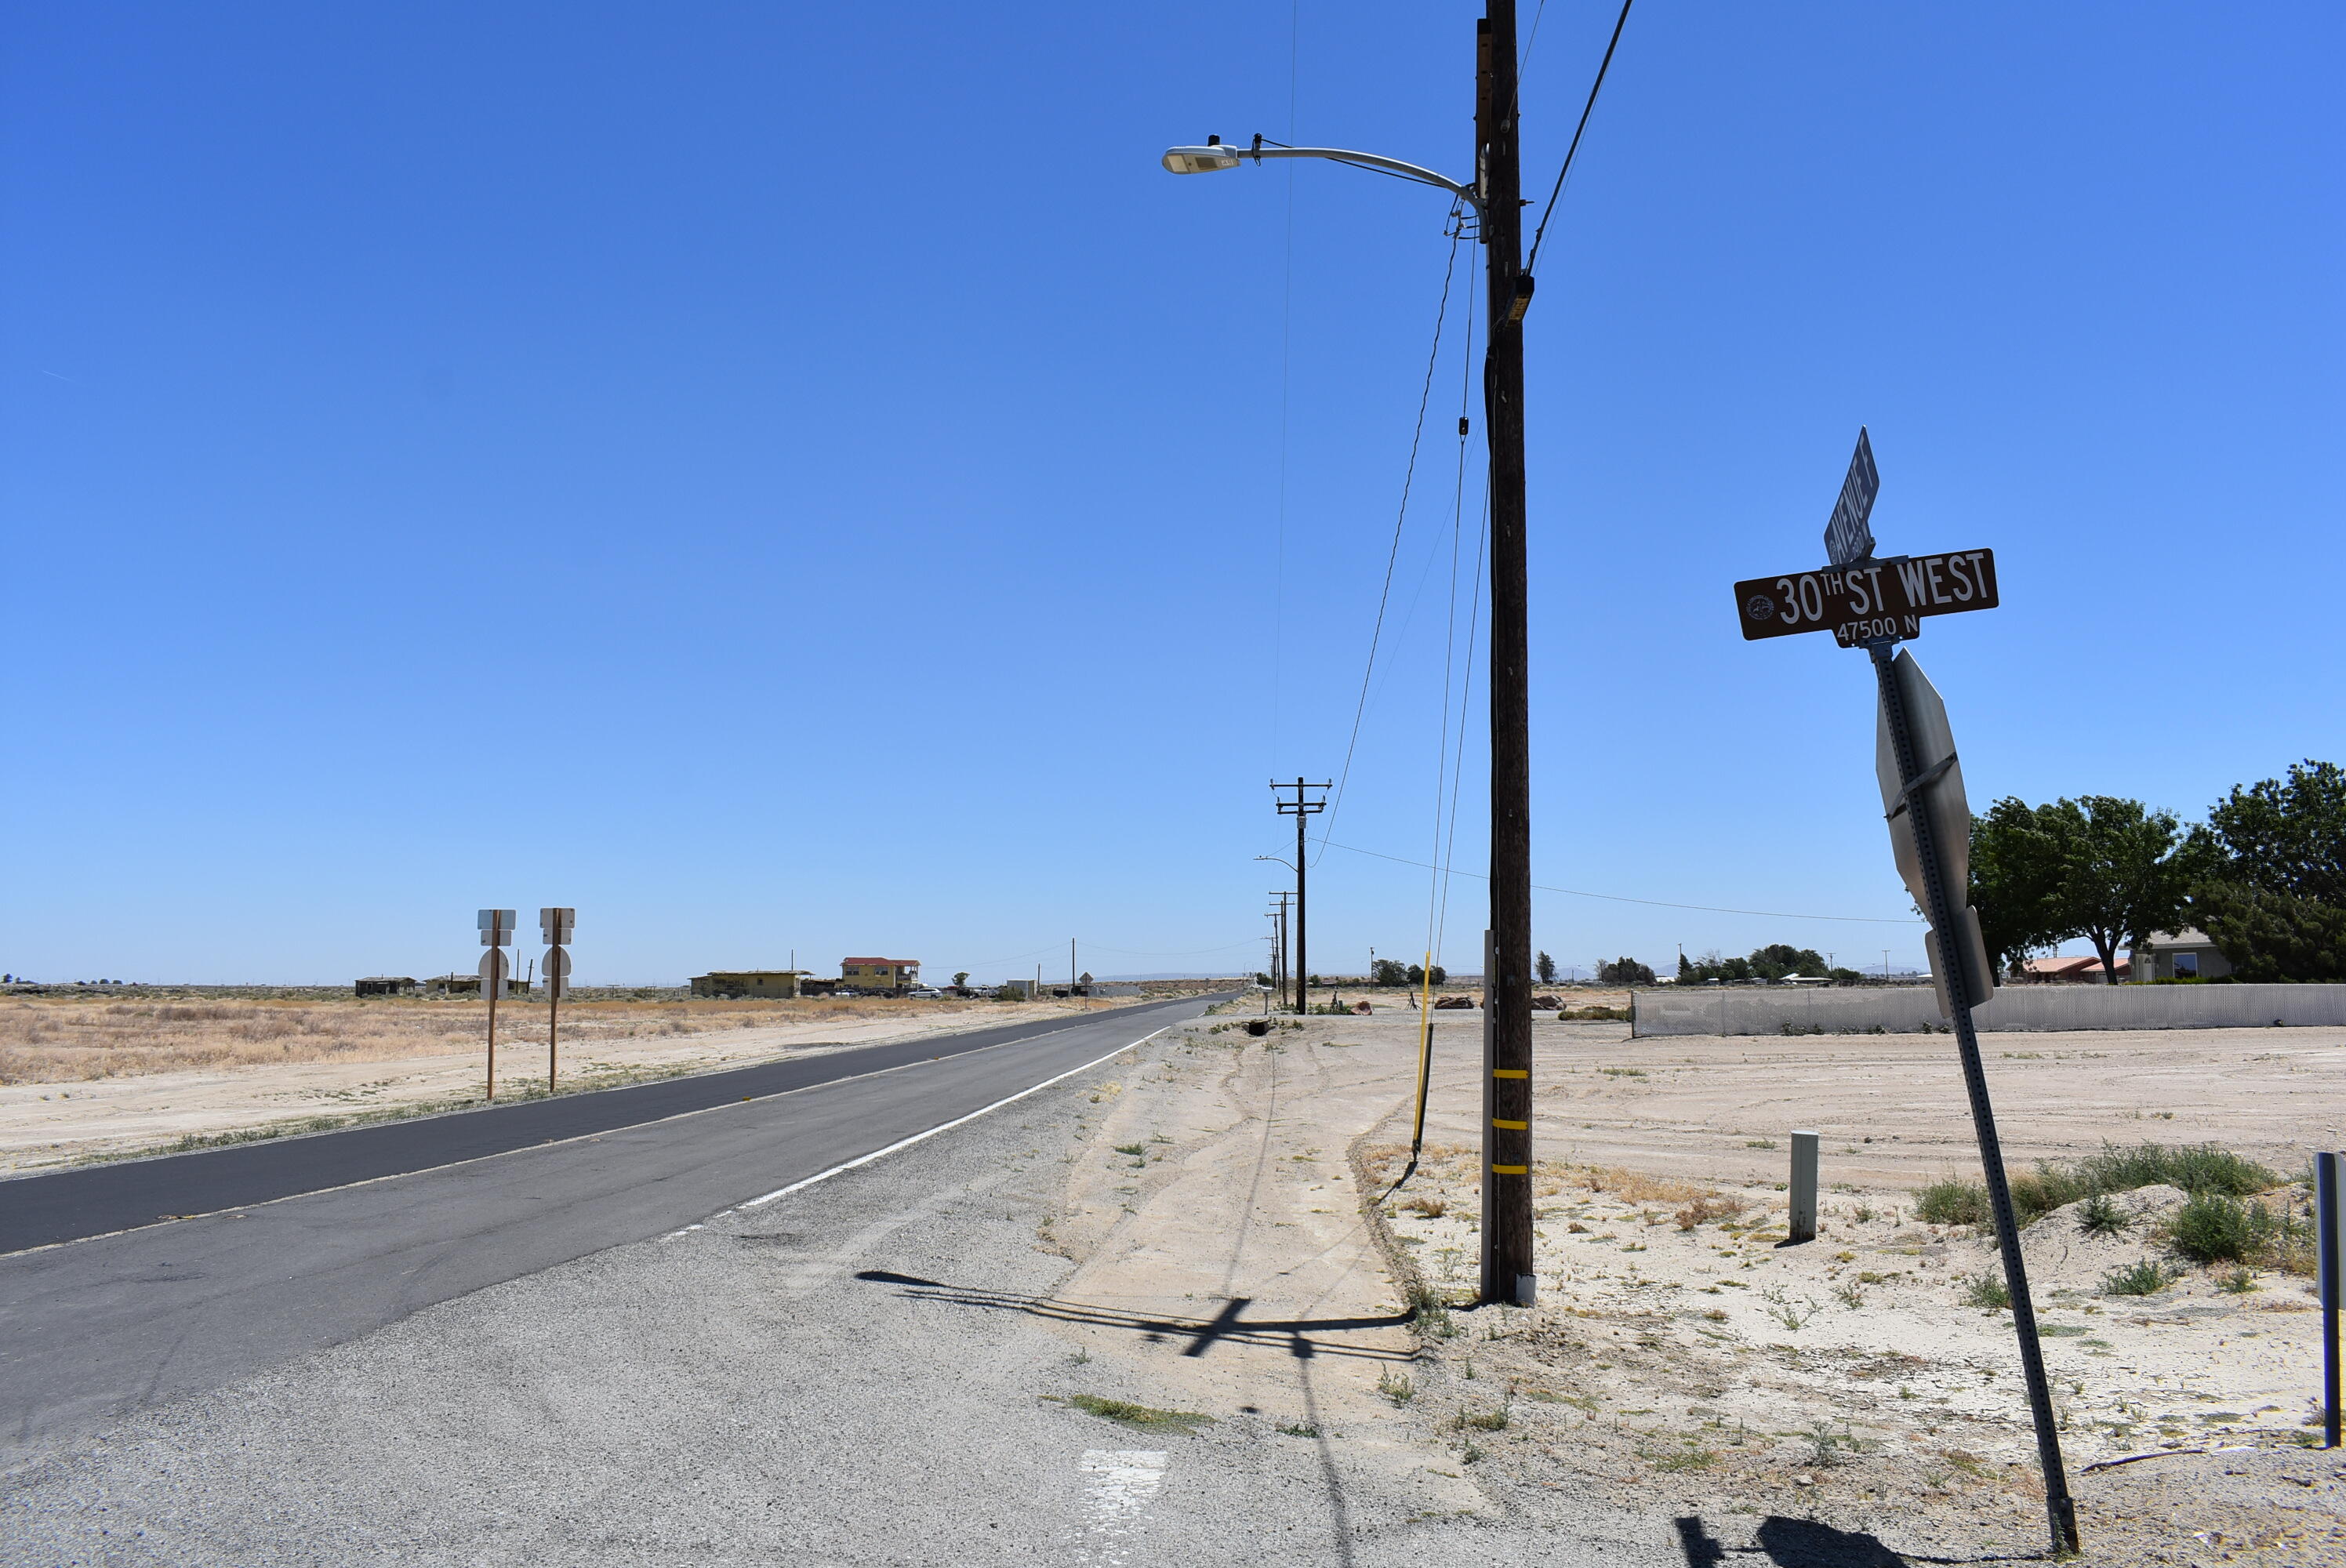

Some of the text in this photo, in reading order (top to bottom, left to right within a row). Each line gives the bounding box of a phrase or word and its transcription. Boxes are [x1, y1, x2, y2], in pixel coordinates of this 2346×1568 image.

[1832, 434, 1872, 564] AVENUE F
[1846, 567, 1884, 615] ST
[1897, 553, 1988, 607] WEST
[1837, 615, 1918, 641] 47500 N
